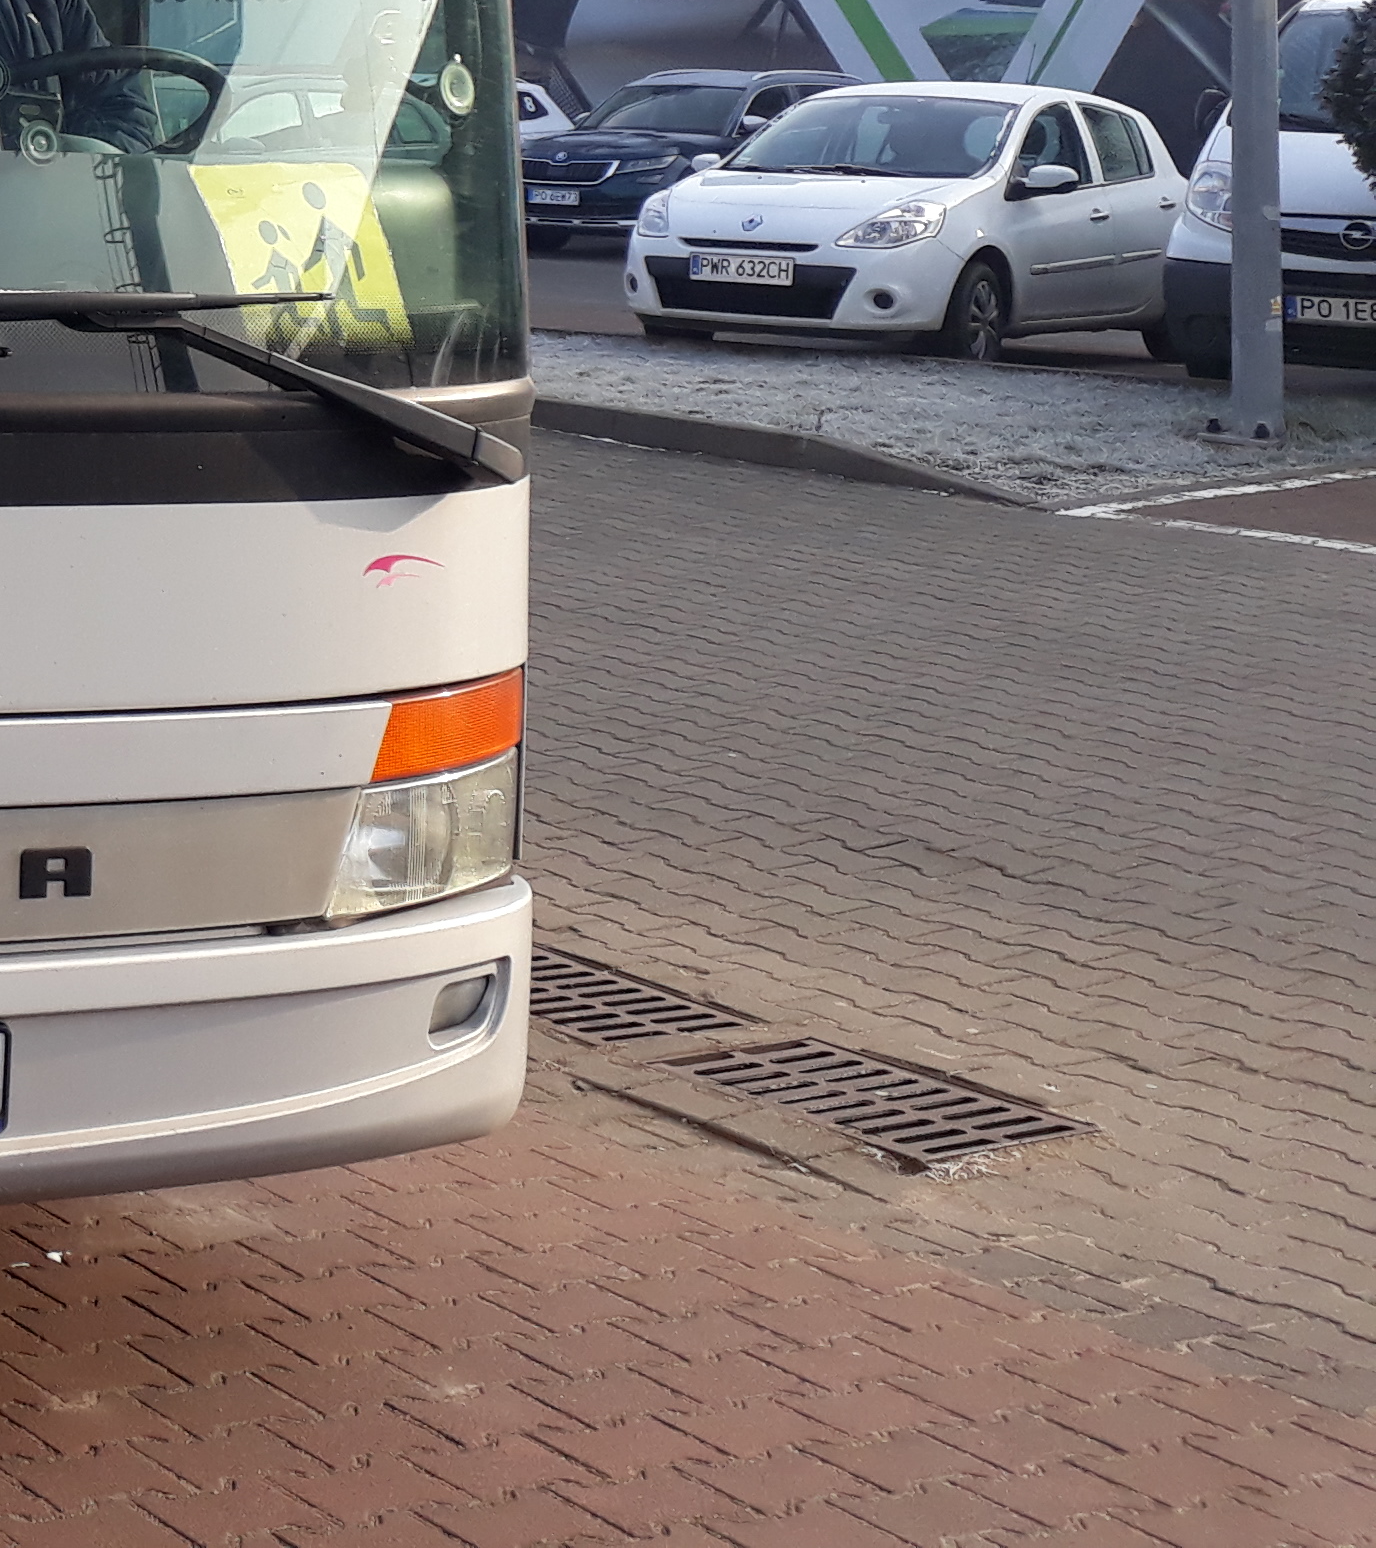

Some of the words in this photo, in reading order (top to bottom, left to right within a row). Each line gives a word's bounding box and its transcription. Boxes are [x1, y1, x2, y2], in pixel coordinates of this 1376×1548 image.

[700, 257, 731, 276] PWR
[736, 259, 790, 280] 632CH
[1300, 297, 1332, 319] PO
